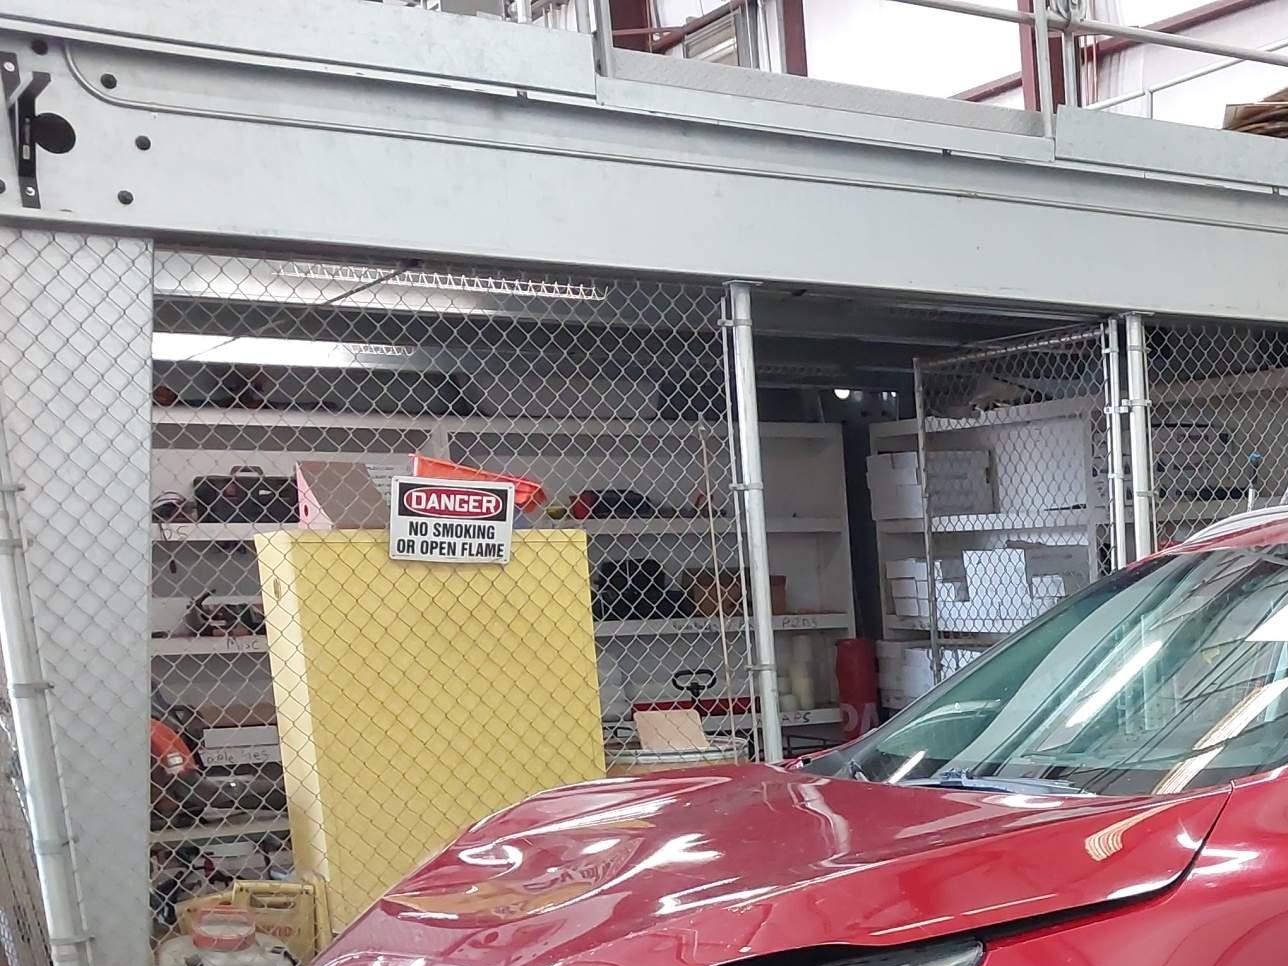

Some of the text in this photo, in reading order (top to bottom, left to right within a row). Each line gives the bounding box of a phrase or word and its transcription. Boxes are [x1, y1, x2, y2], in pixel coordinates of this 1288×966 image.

[411, 491, 496, 513] DANGER
[408, 521, 495, 540] NO SMOKING
[396, 539, 504, 558] OR OPEN FLAME
